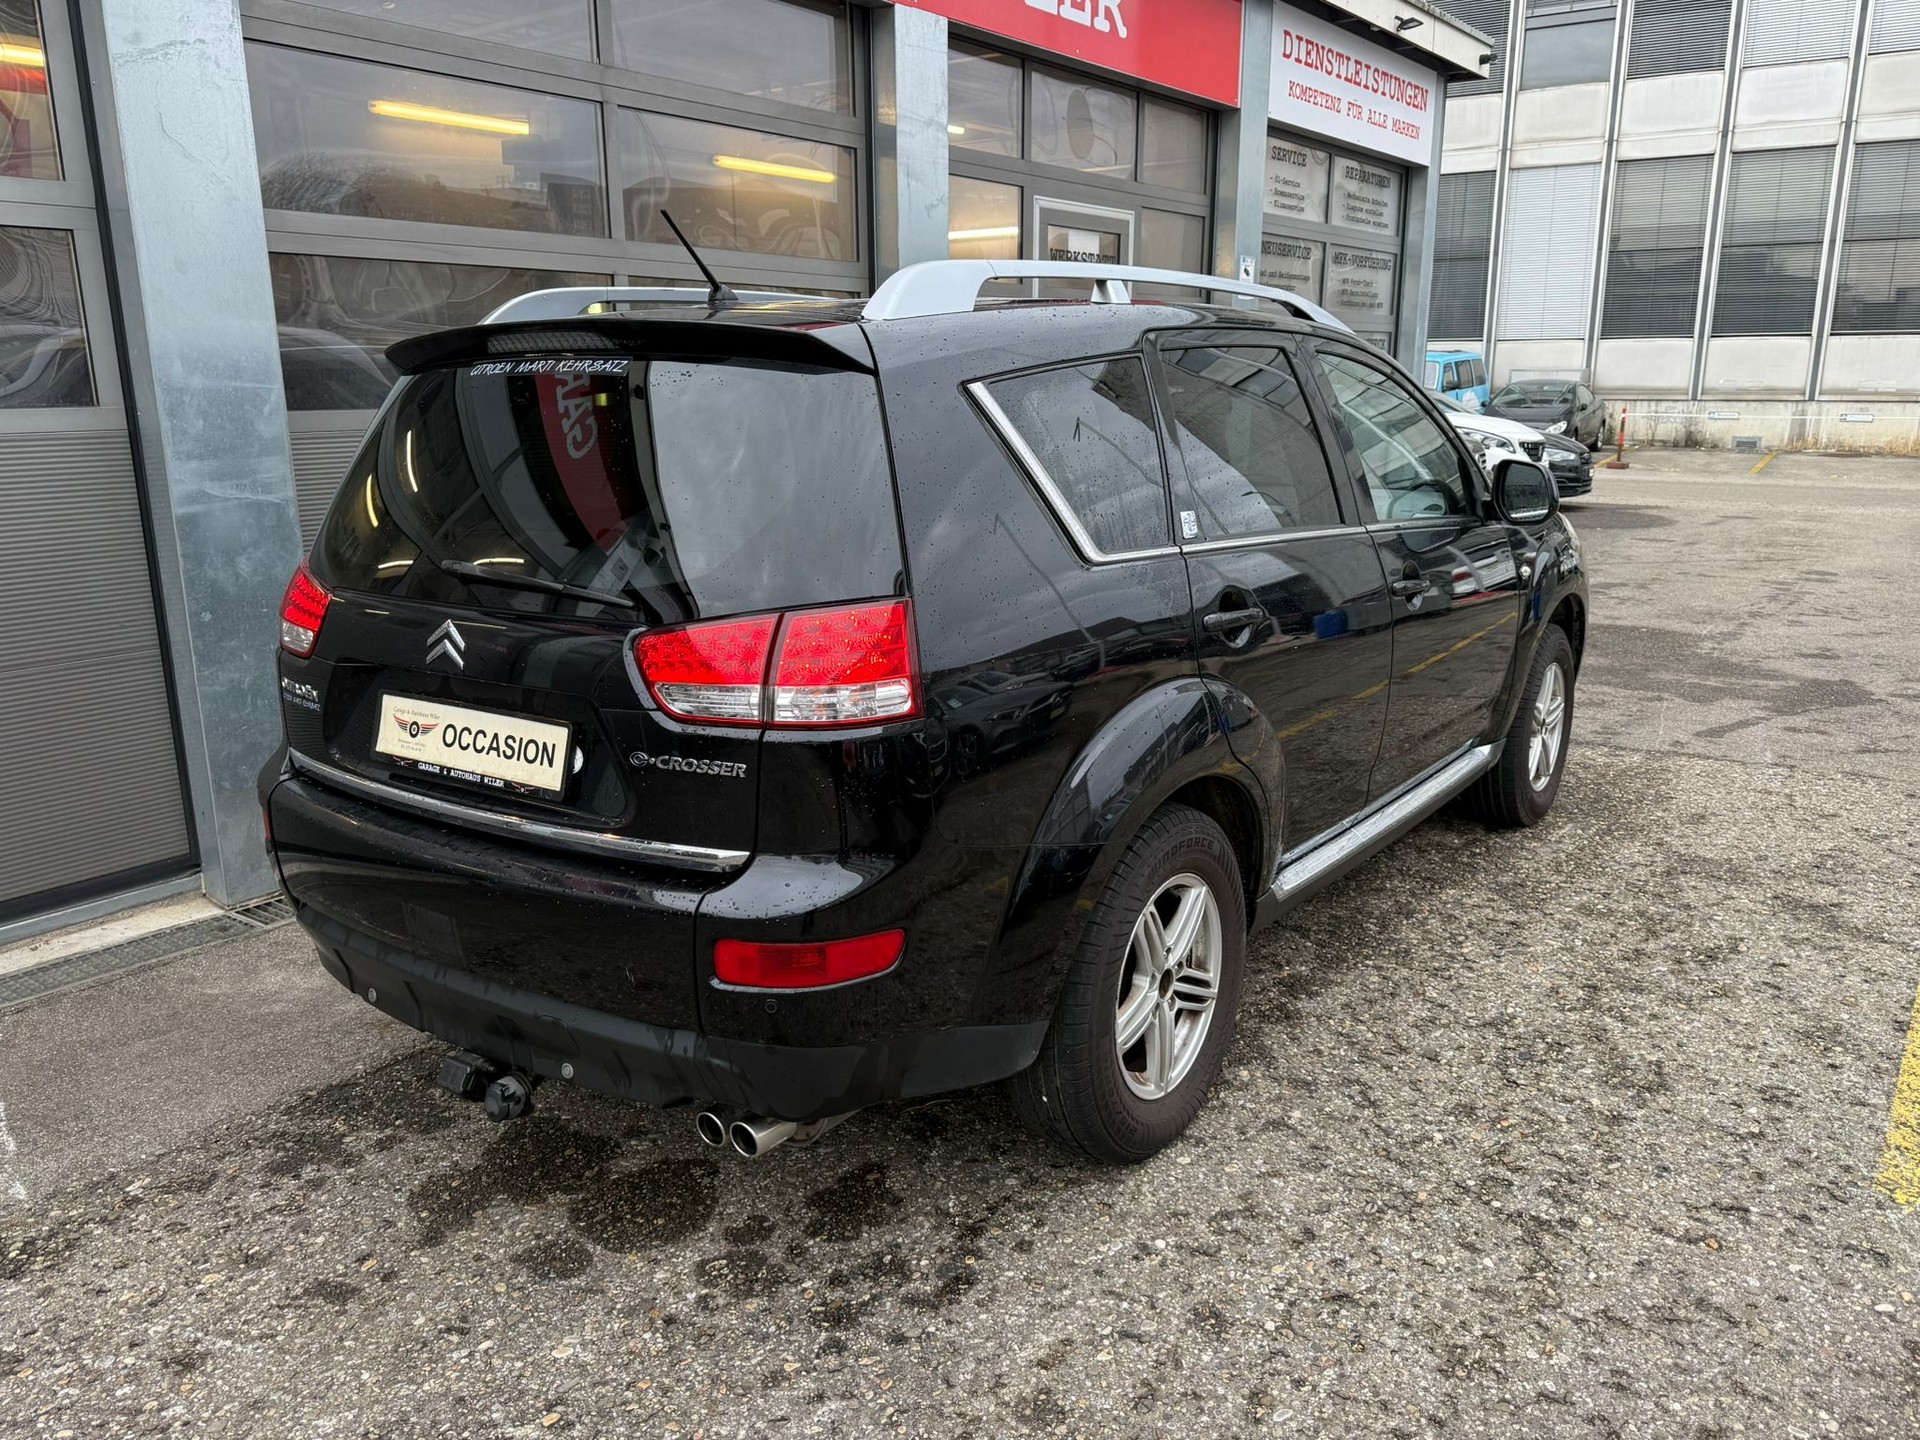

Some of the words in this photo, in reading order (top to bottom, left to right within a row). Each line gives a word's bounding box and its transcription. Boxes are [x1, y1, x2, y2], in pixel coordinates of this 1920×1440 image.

[1282, 29, 1429, 112] DIENSTLEISTUNGEN
[1288, 80, 1342, 114] KOMPETENZ
[1347, 99, 1363, 121] FÜR
[1367, 108, 1388, 129] ALLE
[1392, 117, 1421, 141] MARKEN
[1271, 145, 1307, 167] SERVICE
[1345, 165, 1391, 188] REPARATUREN
[1262, 240, 1312, 260] NEUSERVICE
[471, 362, 515, 376] CITROEN
[515, 360, 555, 373] MARTI
[555, 360, 629, 373] KEHRSATZ
[442, 724, 556, 768] OCCASION
[418, 762, 440, 774] GARAGE
[450, 769, 481, 782] AUTOHAUS
[484, 775, 505, 788] WILER
